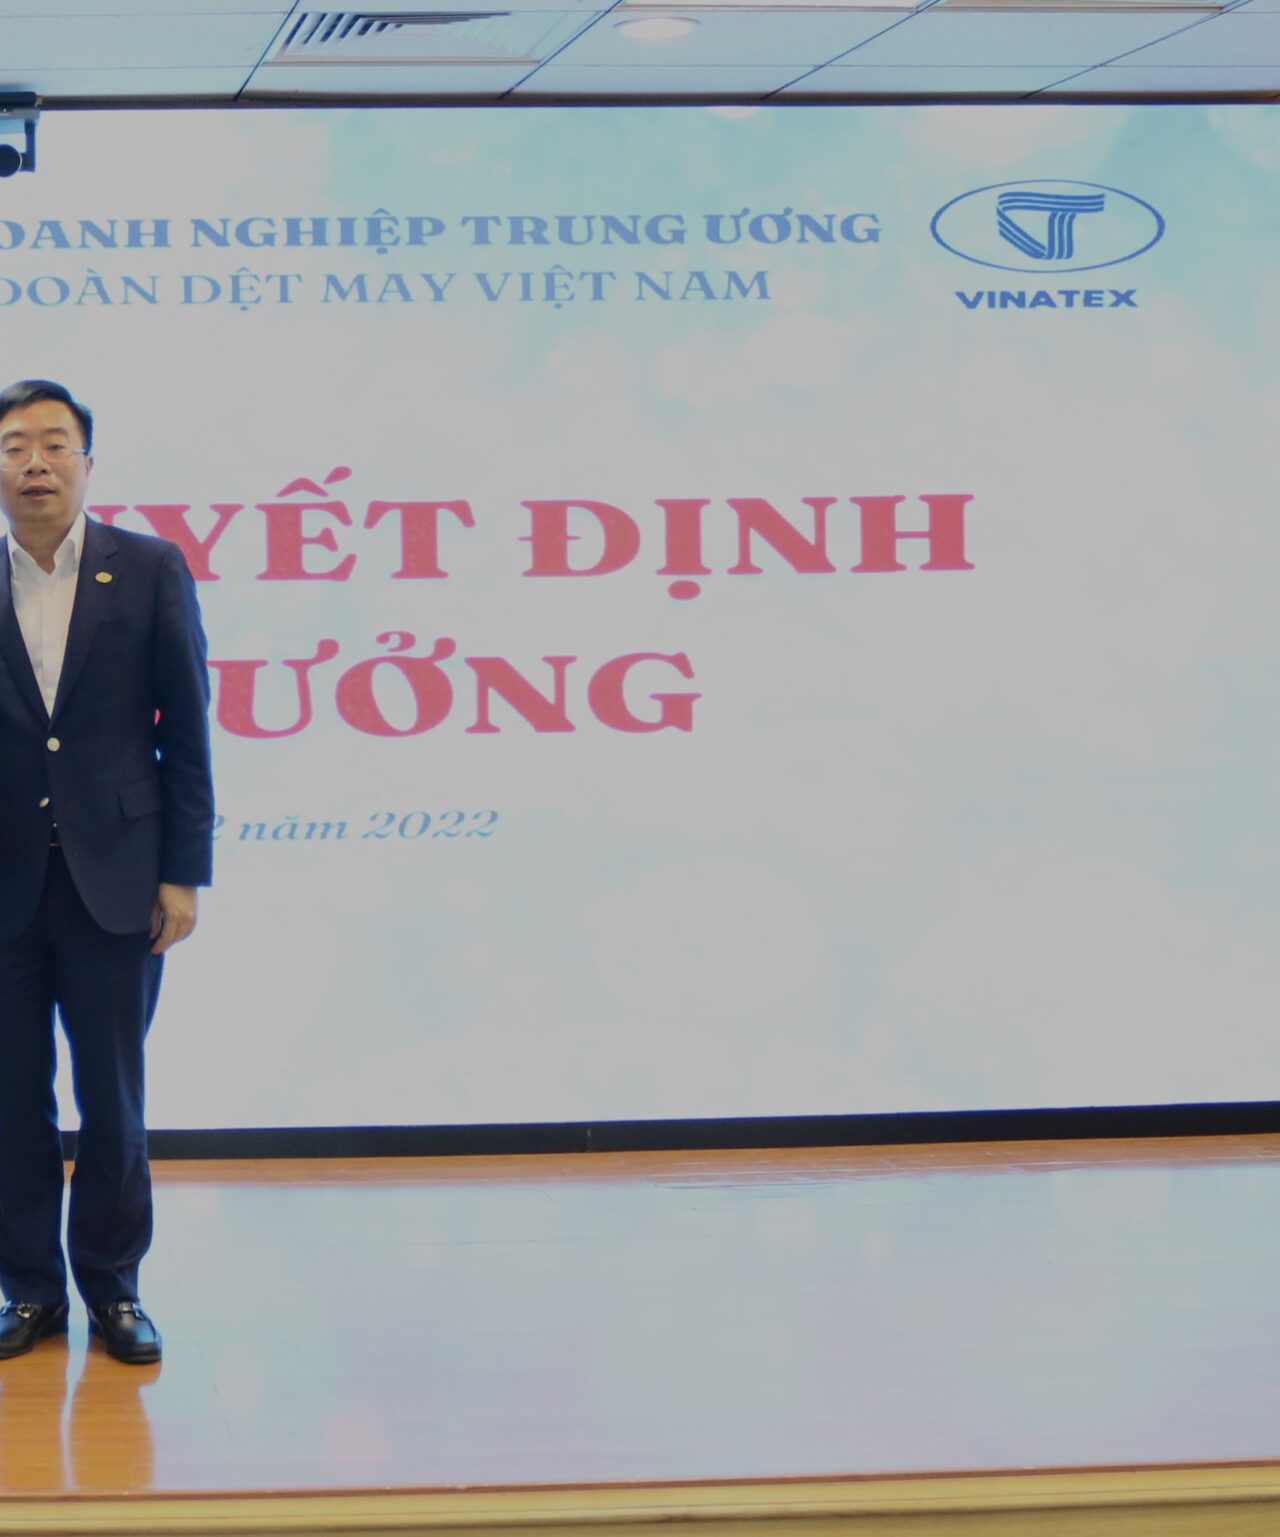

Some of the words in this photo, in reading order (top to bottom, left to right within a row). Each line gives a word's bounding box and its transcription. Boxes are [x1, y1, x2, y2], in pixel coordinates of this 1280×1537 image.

[190, 207, 447, 256] NGHIỆP
[460, 214, 687, 247] TRUNG
[704, 207, 882, 246] ƯƠNG
[181, 267, 304, 313] DỆT
[321, 272, 458, 305] MAY
[473, 263, 617, 310] VIỆT
[634, 269, 772, 302] NAM
[953, 289, 1140, 310] VINATEX
[517, 493, 976, 601] ĐỊNH
[206, 630, 703, 739] ƯỞNG
[238, 815, 348, 841] năm
[362, 810, 499, 839] 2022
